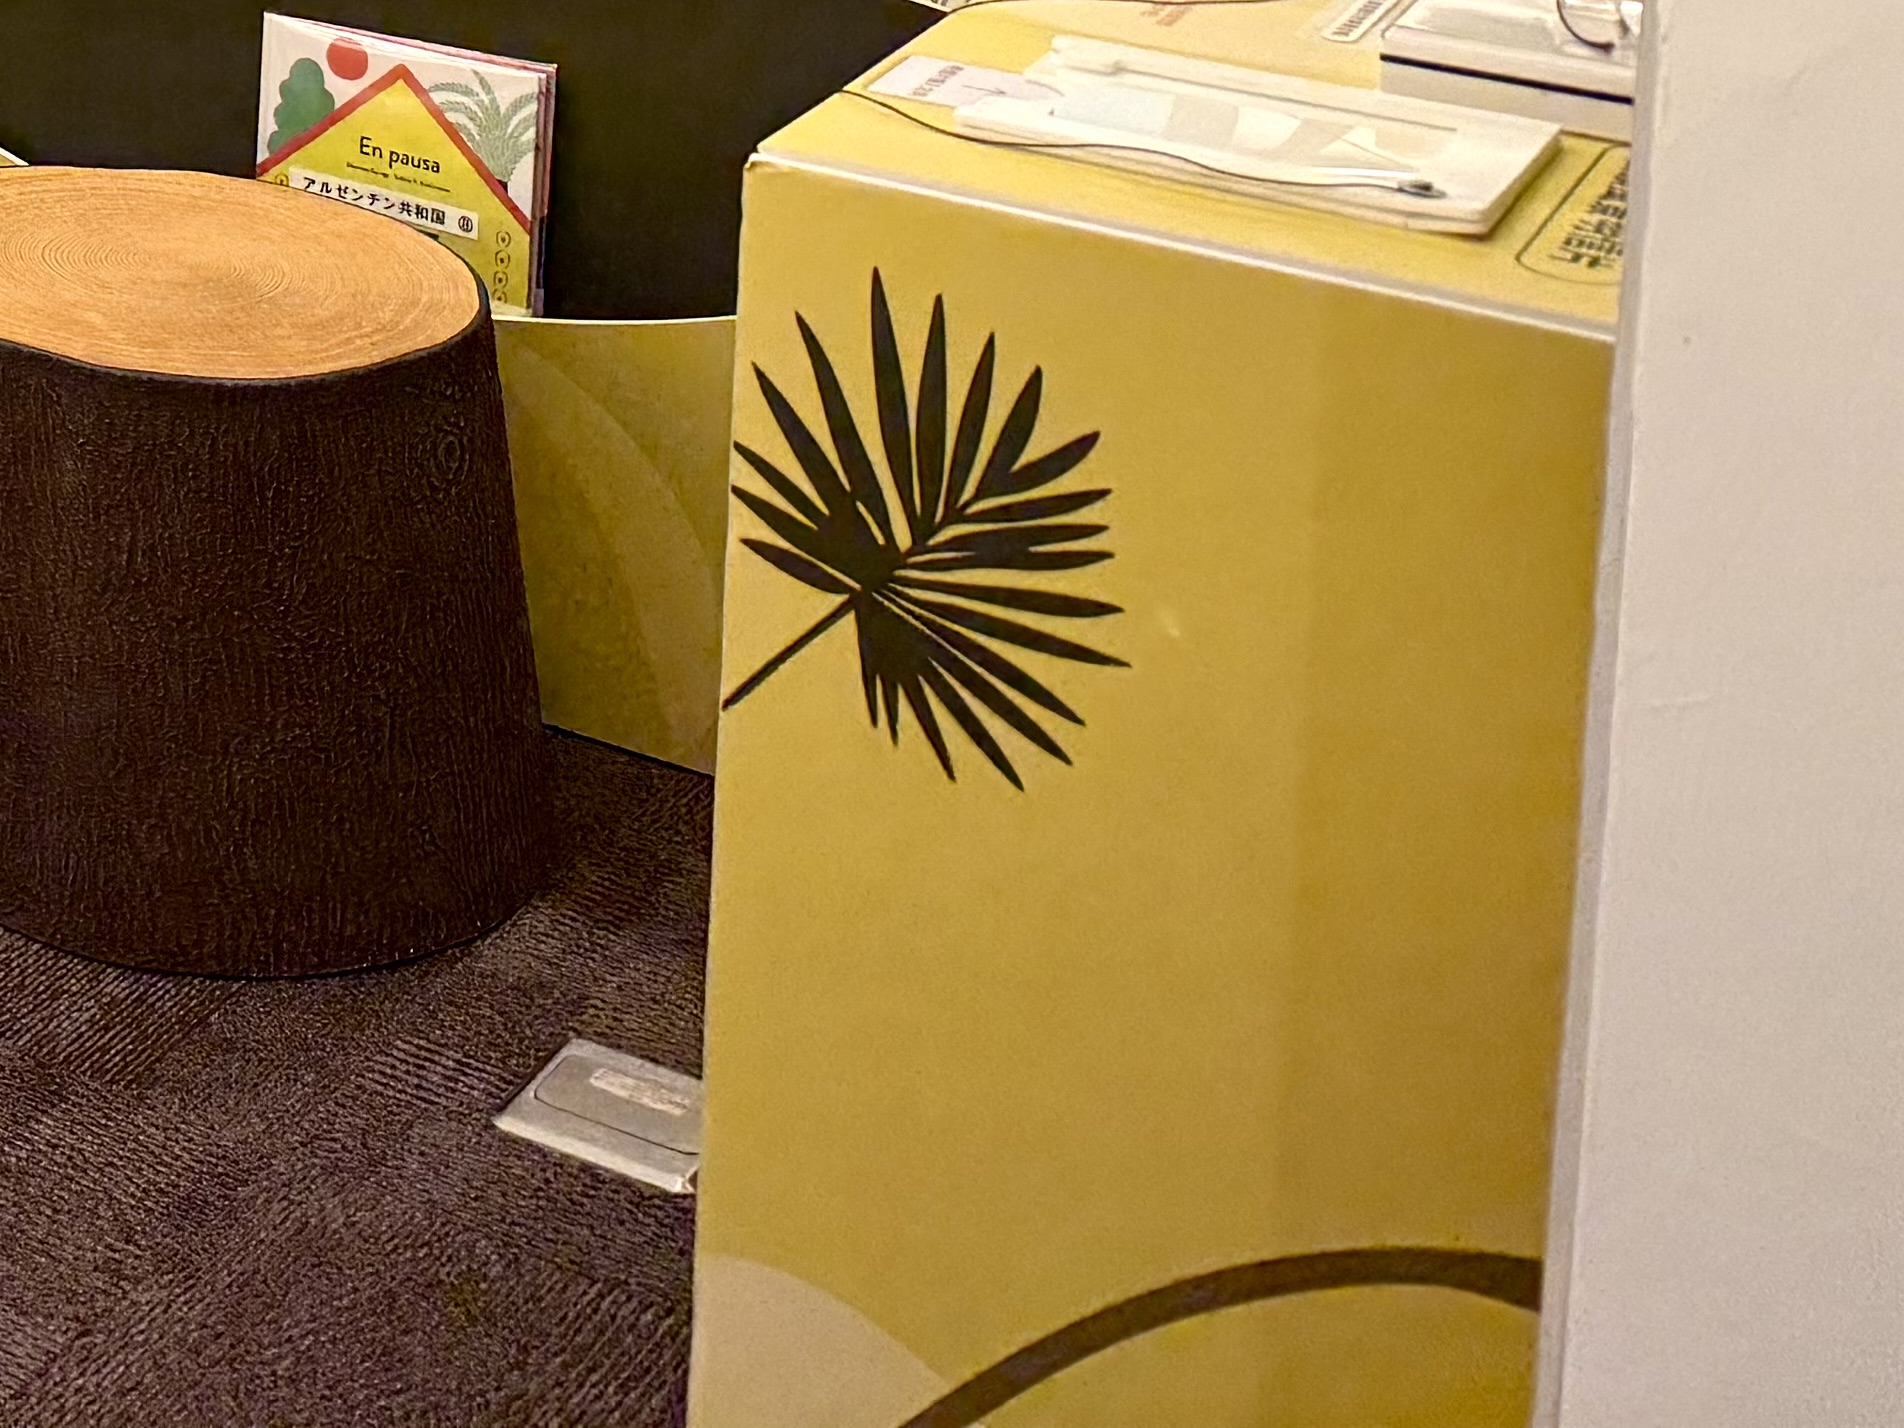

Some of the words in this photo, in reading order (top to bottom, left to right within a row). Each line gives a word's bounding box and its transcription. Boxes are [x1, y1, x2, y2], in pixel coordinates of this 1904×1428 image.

[359, 136, 383, 160] En
[388, 150, 441, 174] pausa
[303, 177, 446, 226] アルゼンチン共和国
